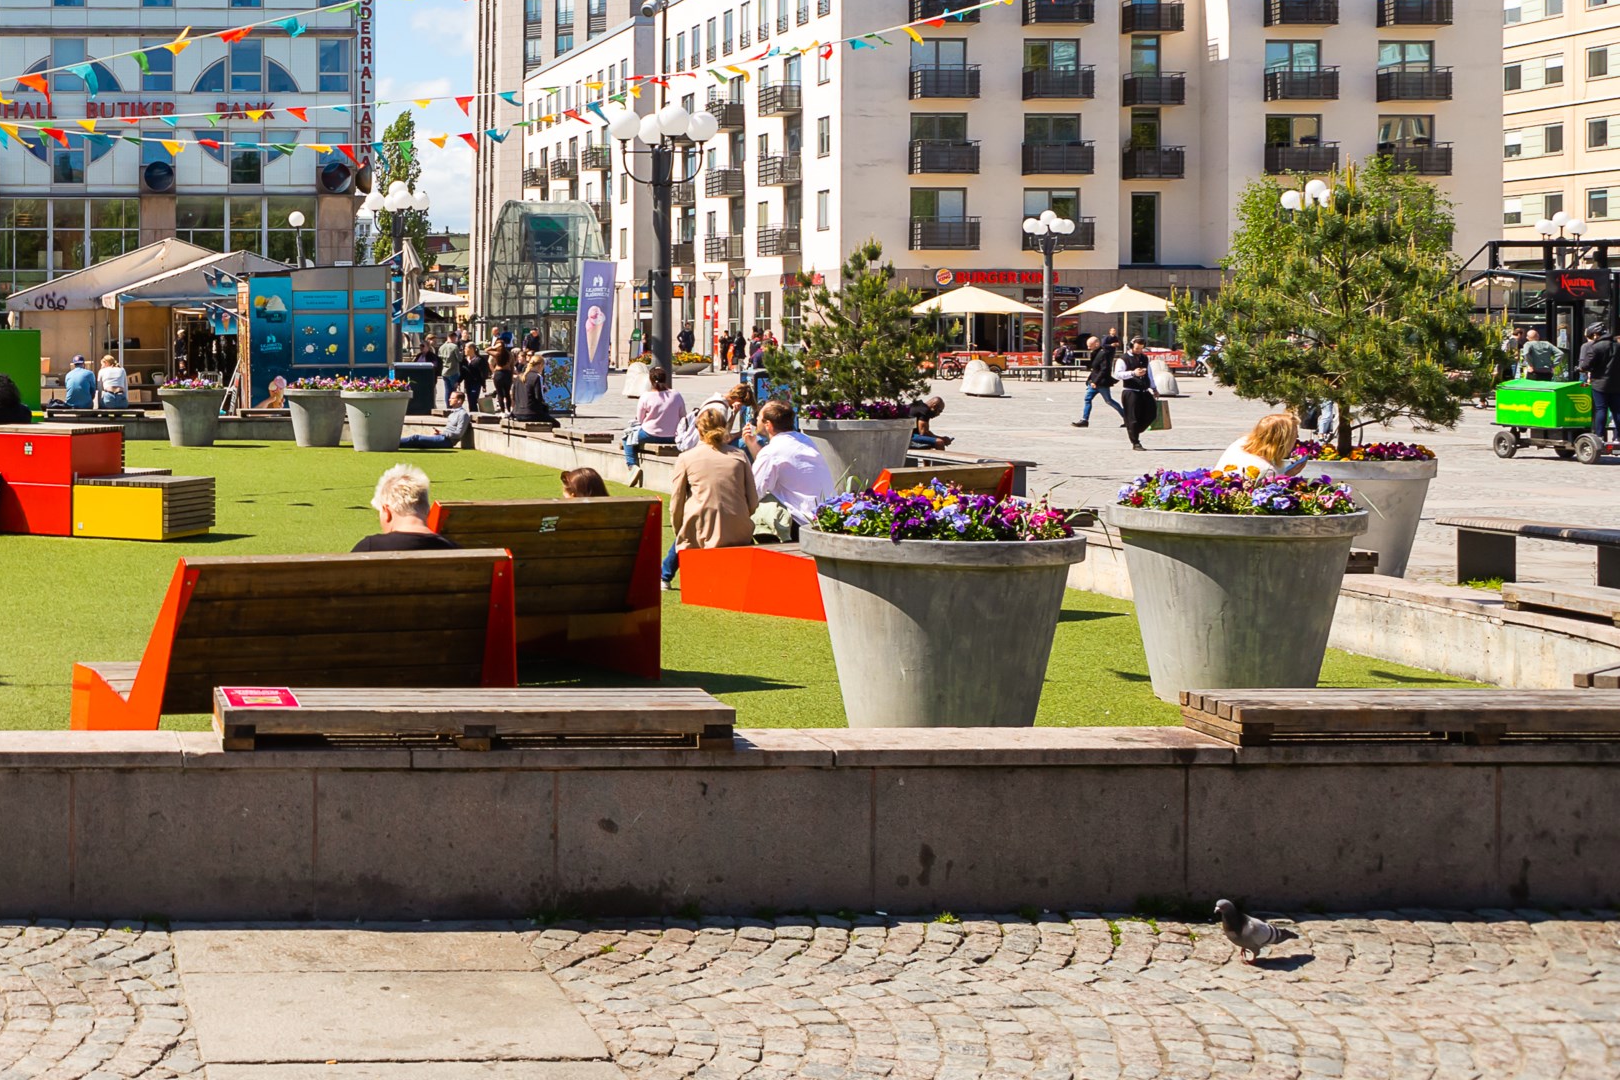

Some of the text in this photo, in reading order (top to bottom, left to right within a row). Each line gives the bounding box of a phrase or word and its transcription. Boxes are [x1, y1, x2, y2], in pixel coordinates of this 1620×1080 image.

[86, 102, 175, 119] BUTIKER
[216, 102, 275, 119] BANK
[955, 271, 1018, 284] BURGER
